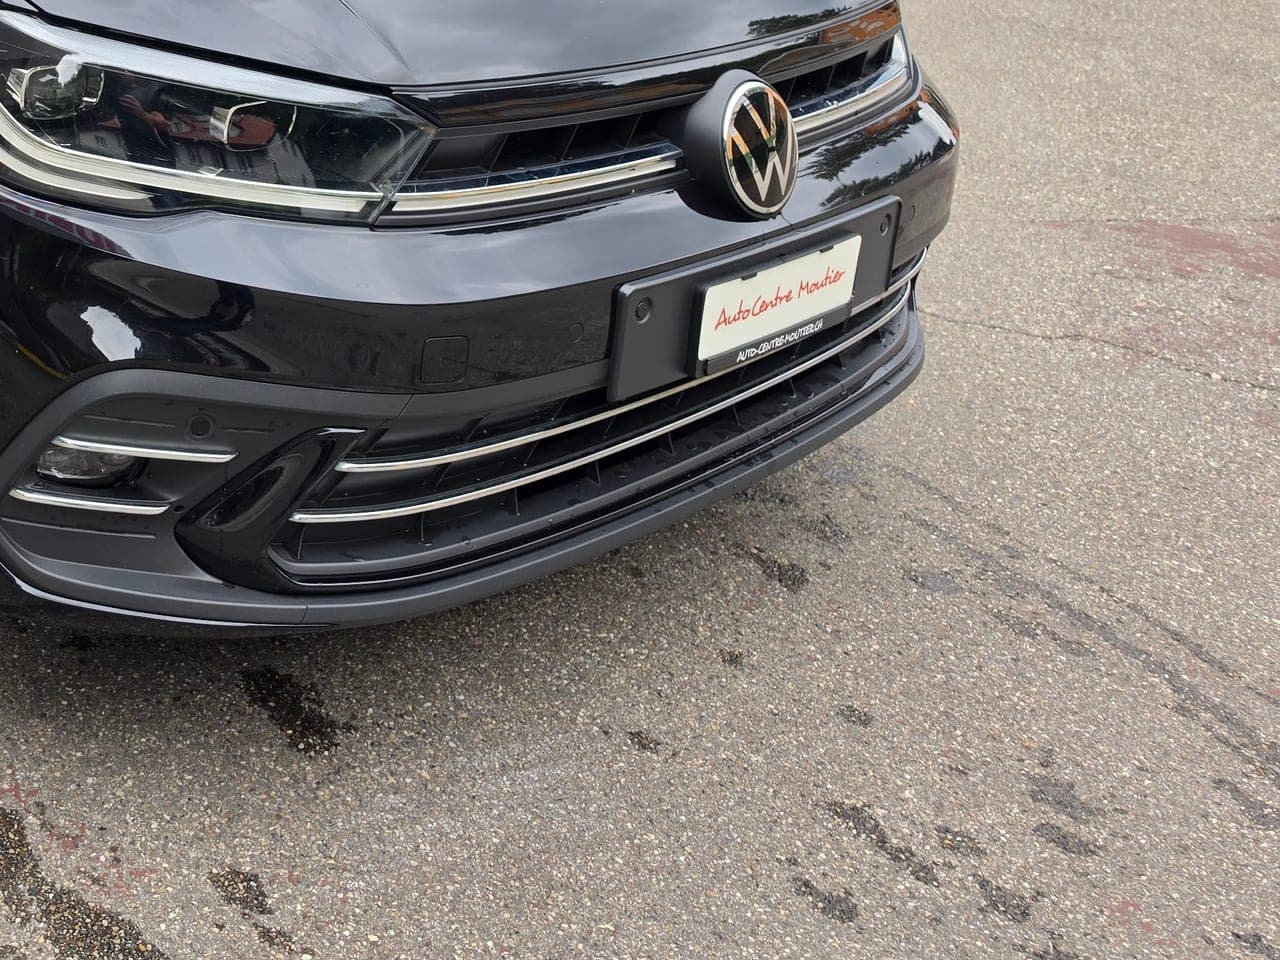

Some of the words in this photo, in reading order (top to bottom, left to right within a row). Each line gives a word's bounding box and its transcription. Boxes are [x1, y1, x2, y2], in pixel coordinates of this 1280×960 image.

[725, 84, 797, 208] VW
[714, 285, 793, 331] AutoCentre
[797, 265, 846, 299] Moutier
[736, 318, 824, 363] AUTO-CENTRE-MOUTIER.CH
